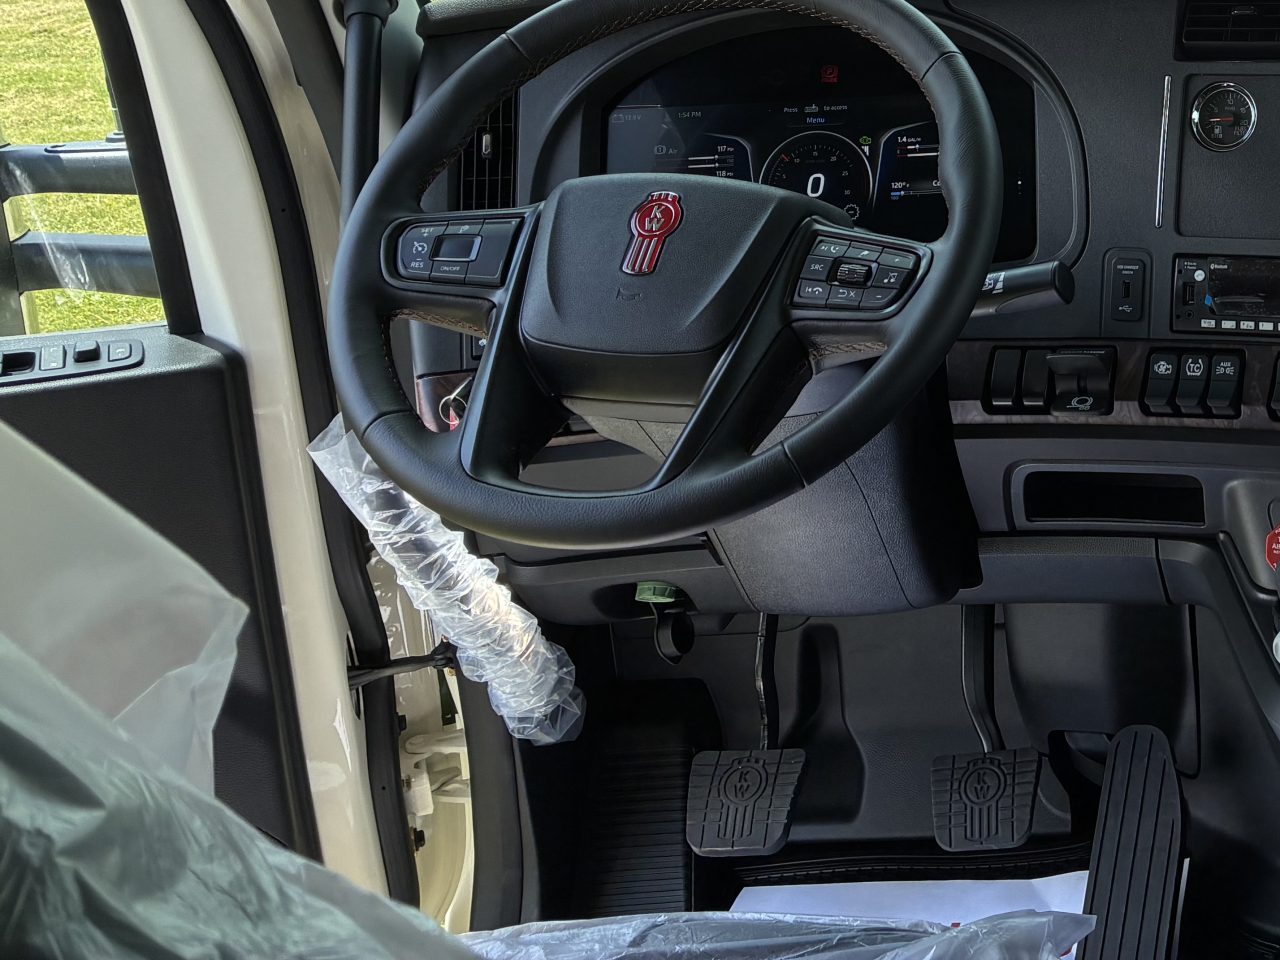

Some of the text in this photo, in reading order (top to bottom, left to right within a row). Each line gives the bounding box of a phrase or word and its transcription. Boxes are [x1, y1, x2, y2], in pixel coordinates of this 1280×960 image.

[806, 173, 825, 198] 0
[652, 205, 663, 218] K
[644, 218, 663, 231] W
[810, 263, 824, 271] SRC
[1189, 364, 1200, 372] TC
